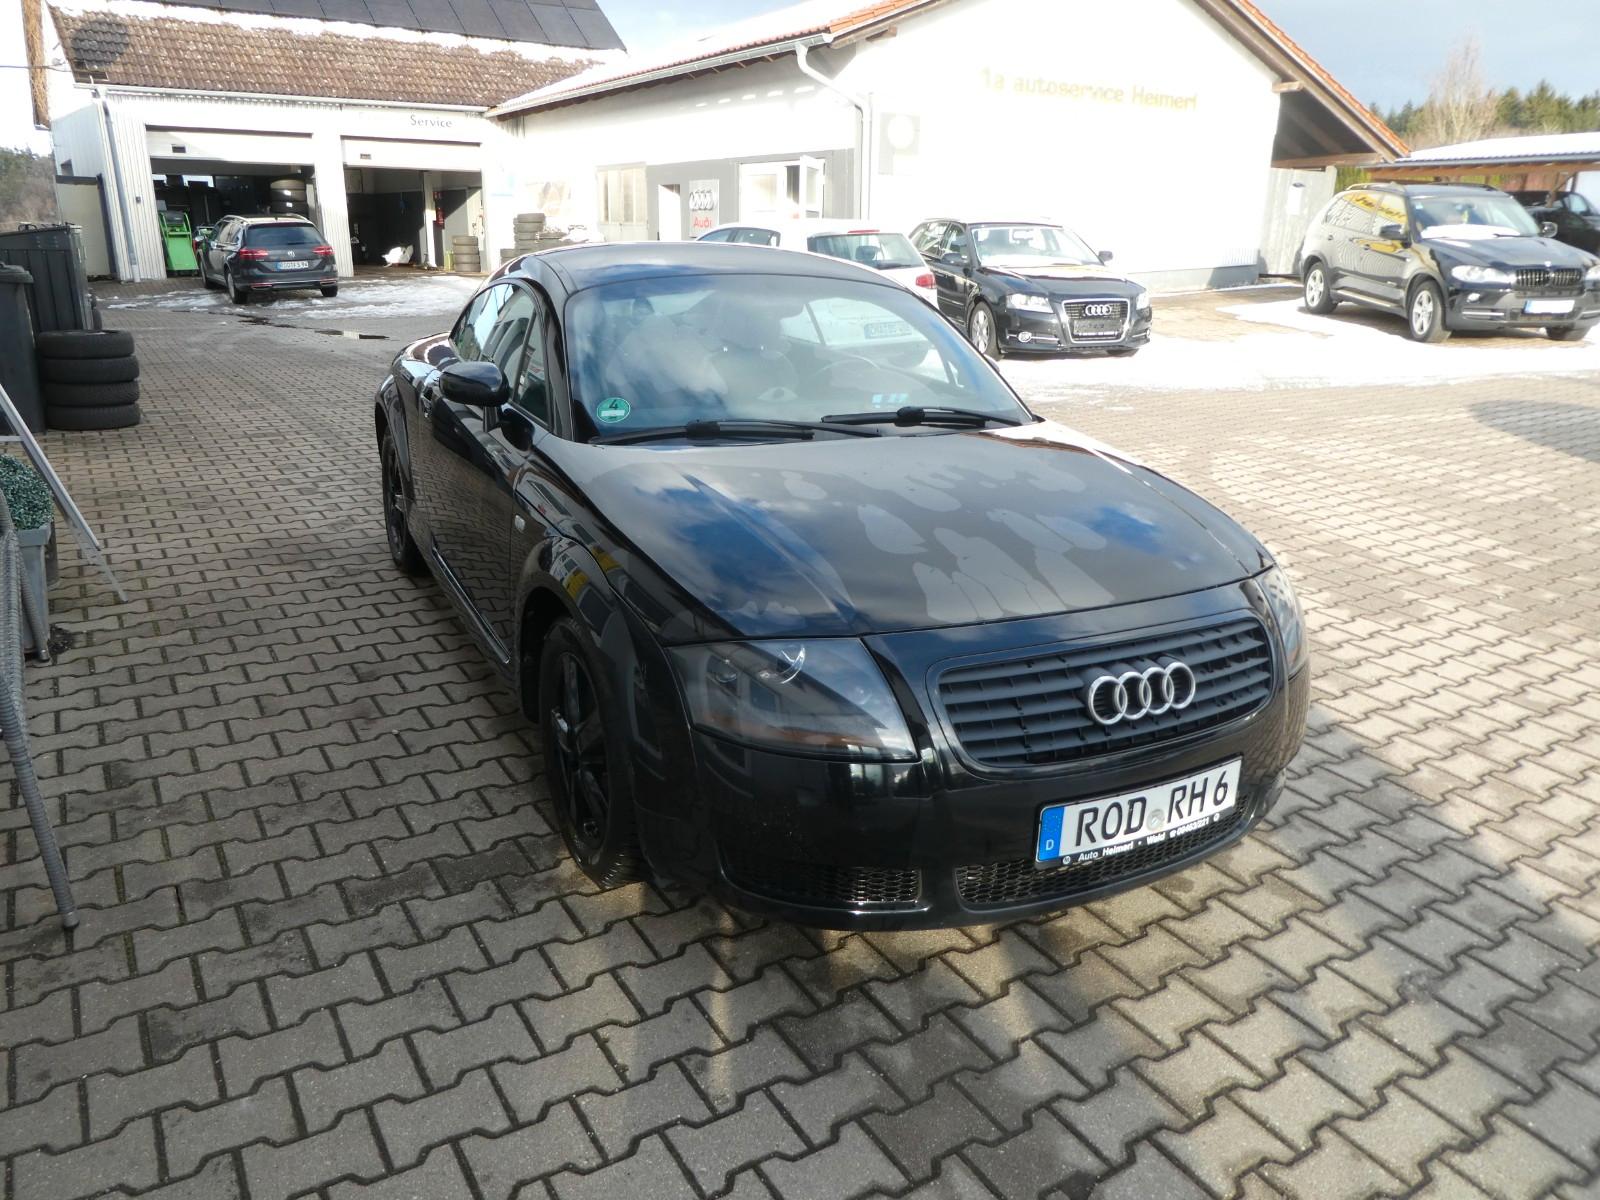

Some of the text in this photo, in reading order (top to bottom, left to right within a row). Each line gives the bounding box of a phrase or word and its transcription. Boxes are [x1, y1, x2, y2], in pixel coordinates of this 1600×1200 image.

[410, 113, 453, 127] Service
[693, 216, 712, 228] Audi
[609, 399, 619, 410] 4
[1075, 770, 1228, 847] ROD RH 6
[1045, 839, 1054, 850] D
[1078, 851, 1099, 862] Auto
[1102, 841, 1134, 857] Heimerl
